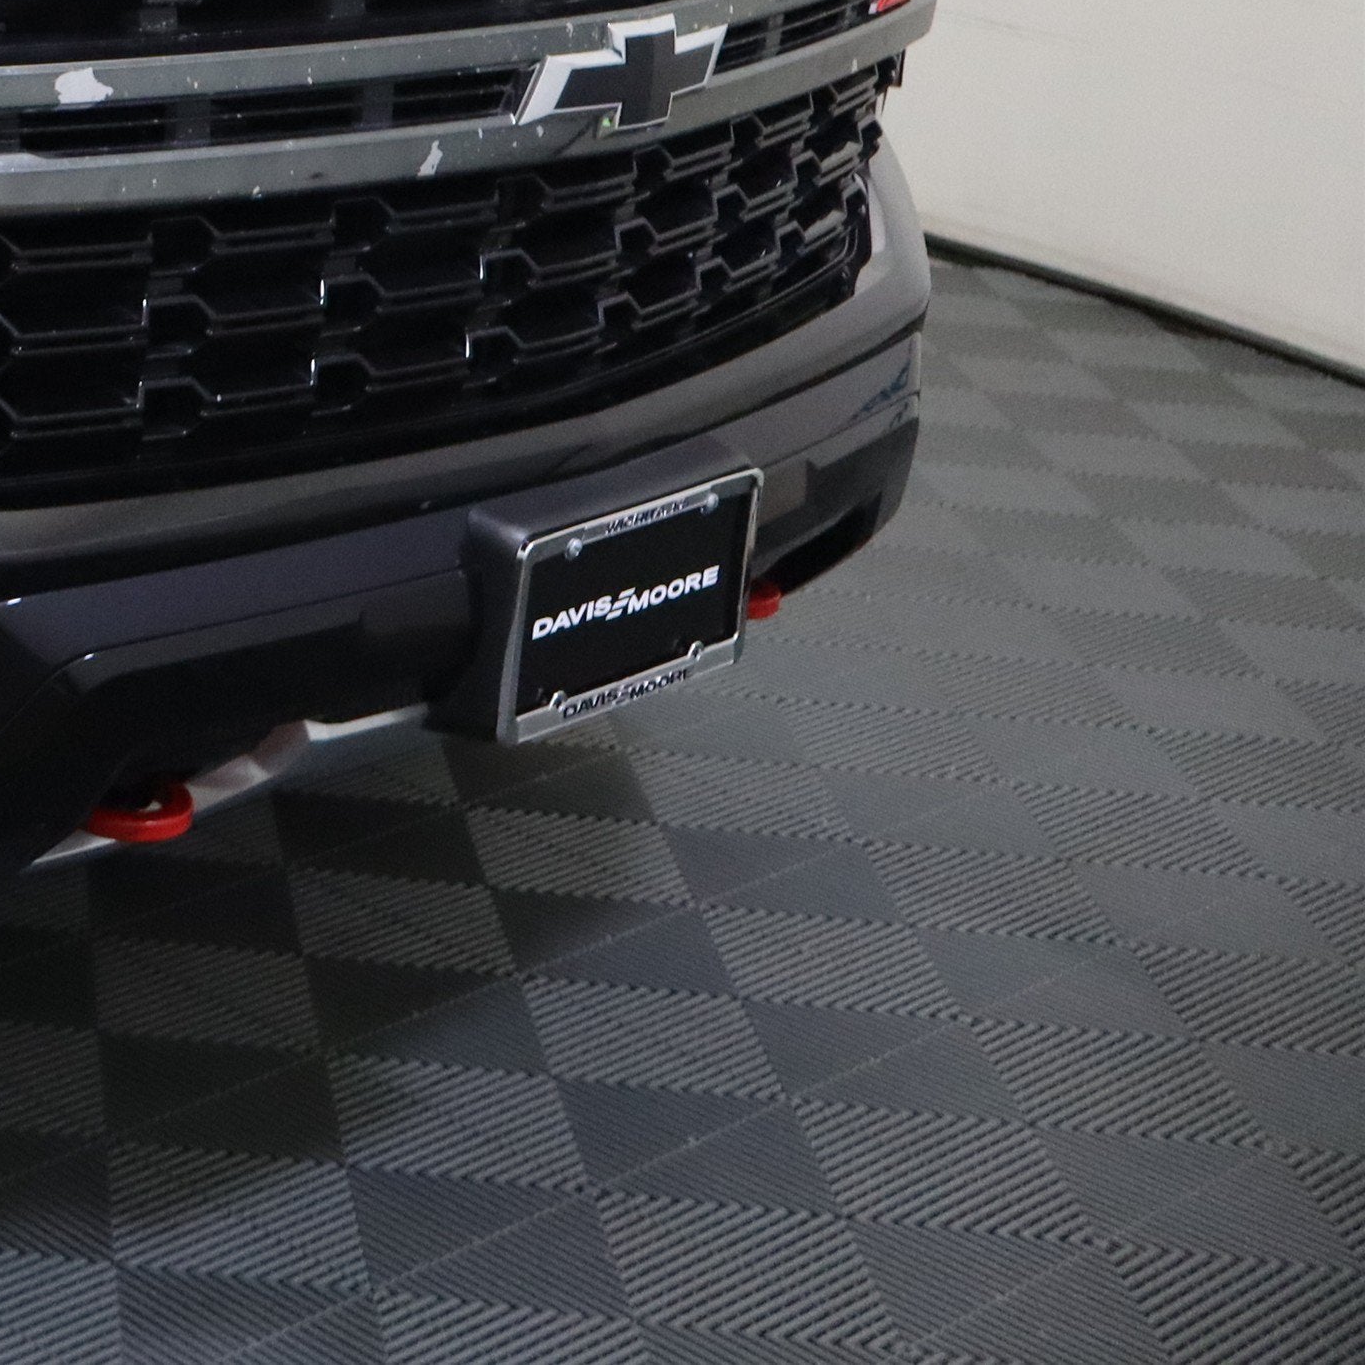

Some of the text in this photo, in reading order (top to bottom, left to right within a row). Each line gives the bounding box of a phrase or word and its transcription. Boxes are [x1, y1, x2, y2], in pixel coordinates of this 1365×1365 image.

[532, 565, 720, 640] DAVIS MOORE
[563, 689, 619, 718] DAVIS
